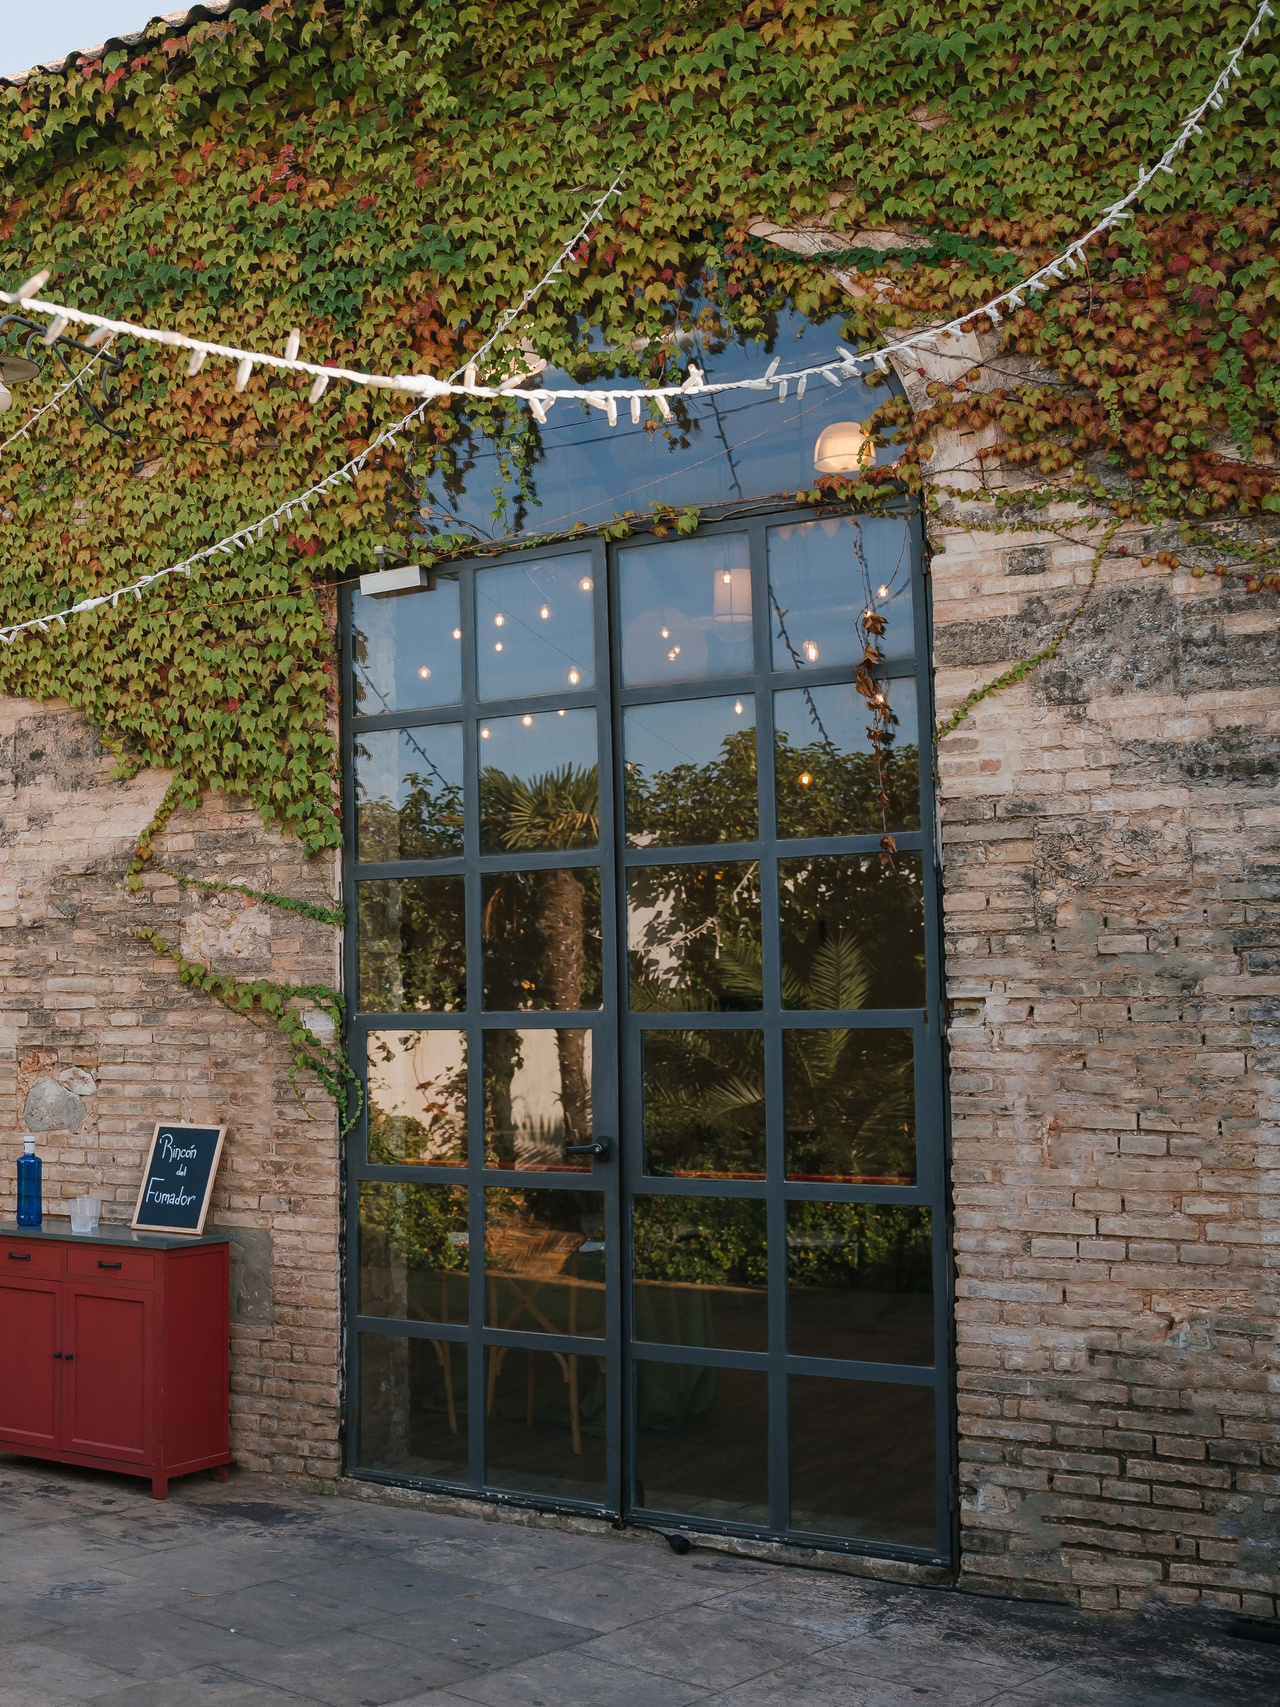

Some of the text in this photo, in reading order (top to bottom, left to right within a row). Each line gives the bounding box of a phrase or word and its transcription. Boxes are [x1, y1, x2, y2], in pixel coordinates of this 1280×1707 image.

[159, 1133, 197, 1163] Rincón
[176, 1163, 187, 1176] del
[145, 1177, 196, 1206] Fumador
